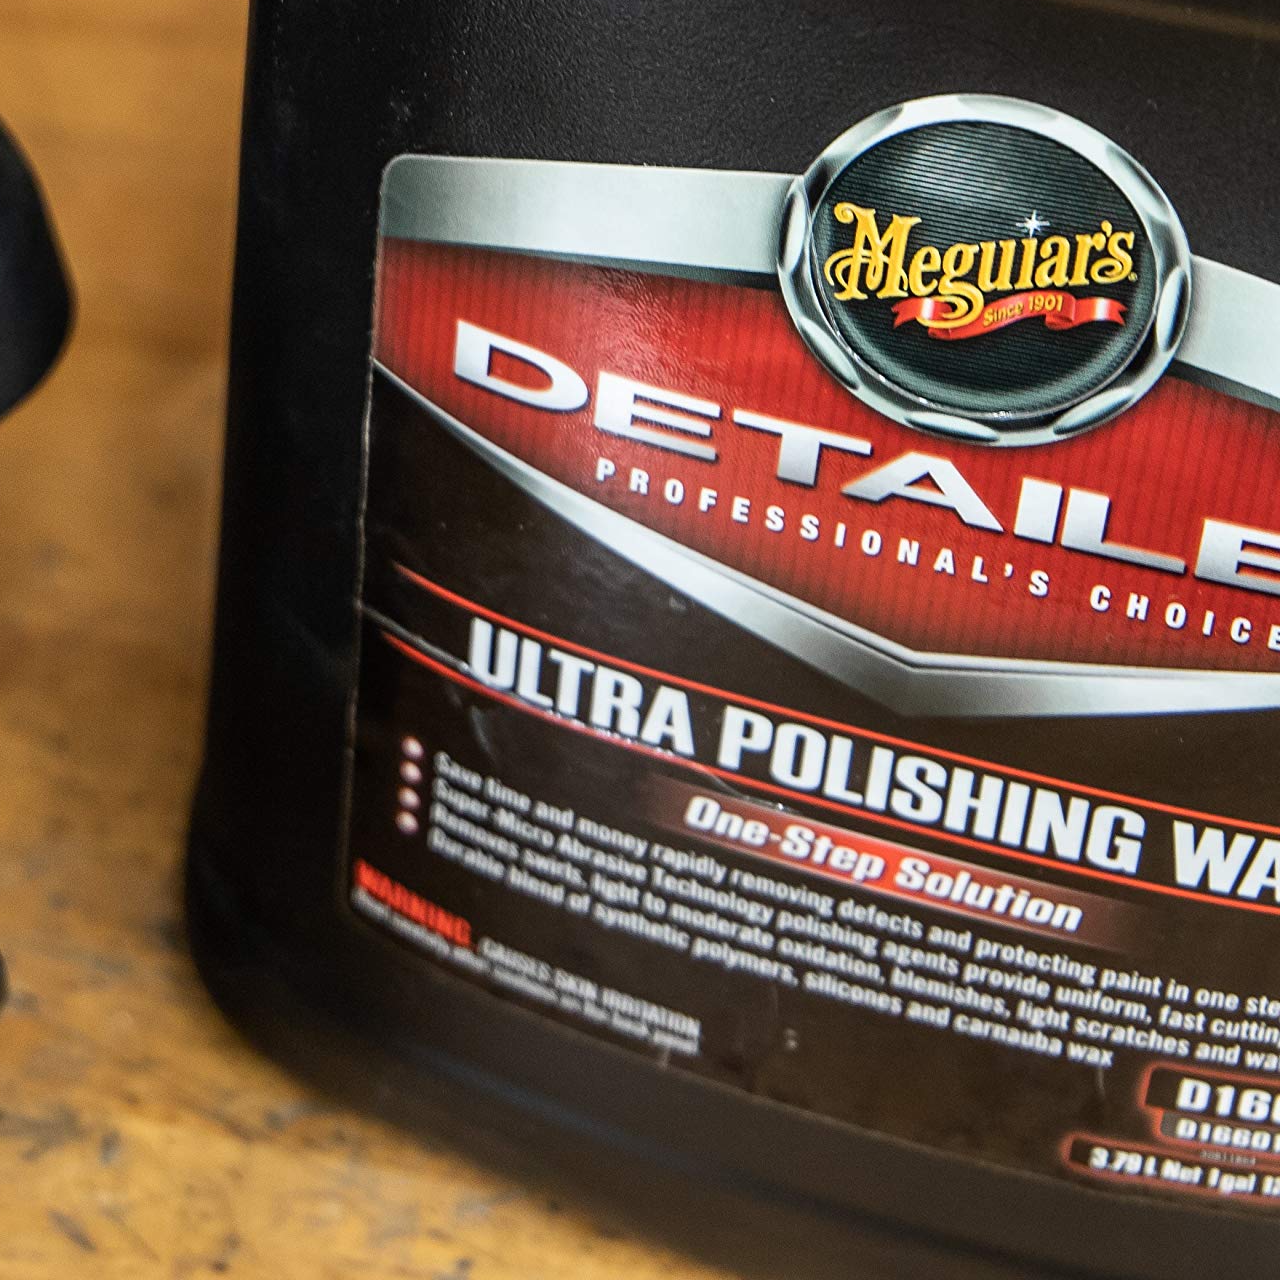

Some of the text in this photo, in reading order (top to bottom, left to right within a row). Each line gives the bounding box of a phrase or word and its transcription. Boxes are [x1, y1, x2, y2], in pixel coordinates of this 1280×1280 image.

[824, 202, 1137, 329] Meguiar's
[983, 294, 1064, 327] Since 1901
[453, 319, 1280, 597] DETAILE
[595, 455, 1051, 599] PROFESSIONAL'S
[468, 616, 696, 757] ULTRA
[717, 704, 1146, 875] POLISHING
[532, 800, 575, 831] and
[575, 816, 649, 859] money
[649, 842, 727, 885] rapidly
[729, 868, 835, 918] removing
[837, 898, 924, 939] defects
[927, 925, 973, 952] and
[975, 936, 1097, 987] protecting
[1099, 967, 1163, 998] paint
[1166, 977, 1190, 1004] in
[1194, 987, 1240, 1012] one
[555, 832, 648, 884] Abrasive
[651, 865, 775, 926] Technology
[775, 908, 880, 959] polishing
[881, 939, 960, 977] agents
[962, 961, 1052, 1000] provide
[1054, 984, 1153, 1025] uniform,
[1158, 1003, 1207, 1034] fast
[1210, 1016, 1280, 1050] cuttin
[684, 792, 1084, 933] One-Step Solution
[565, 891, 592, 916] of
[590, 900, 691, 953] synthetic
[690, 934, 801, 989] polymers,
[802, 969, 905, 1017] silicones
[905, 1000, 952, 1028] and
[952, 1012, 1065, 1057] carnauba
[1066, 1039, 1115, 1069] wax
[589, 870, 641, 908] light
[640, 890, 667, 919] to
[668, 900, 776, 952] moderate
[776, 936, 887, 987] oxidation,
[890, 966, 1012, 1020] blemishes,
[1016, 998, 1071, 1033] light
[1074, 1015, 1191, 1058] scratches
[1194, 1041, 1242, 1066] and
[1245, 1050, 1280, 1072] wa
[1175, 1076, 1280, 1123] D16
